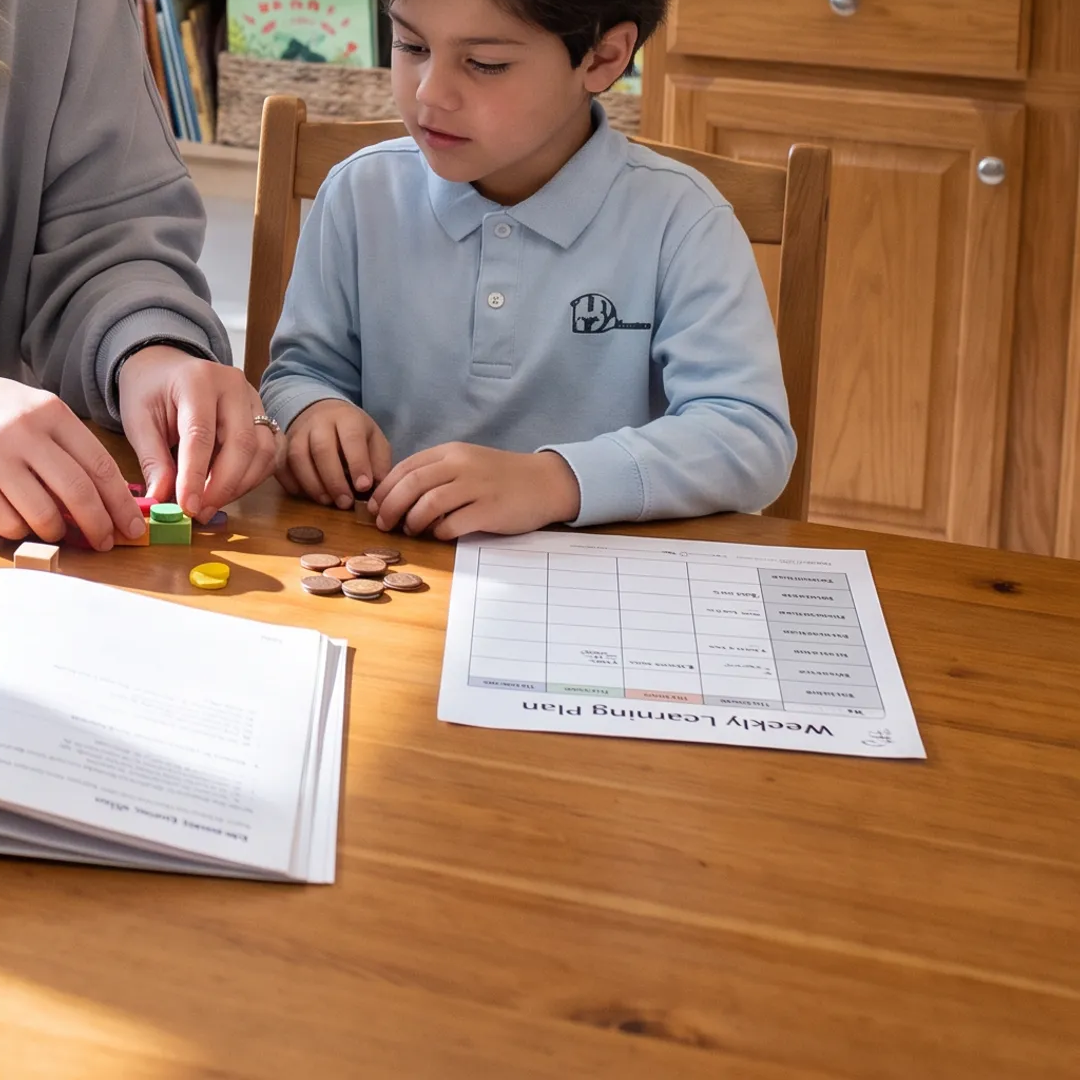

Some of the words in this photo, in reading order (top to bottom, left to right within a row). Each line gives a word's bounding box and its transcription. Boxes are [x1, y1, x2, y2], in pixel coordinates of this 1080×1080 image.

[522, 702, 581, 717] Plan
[592, 705, 717, 727] Learning
[726, 716, 834, 737] Weekly
